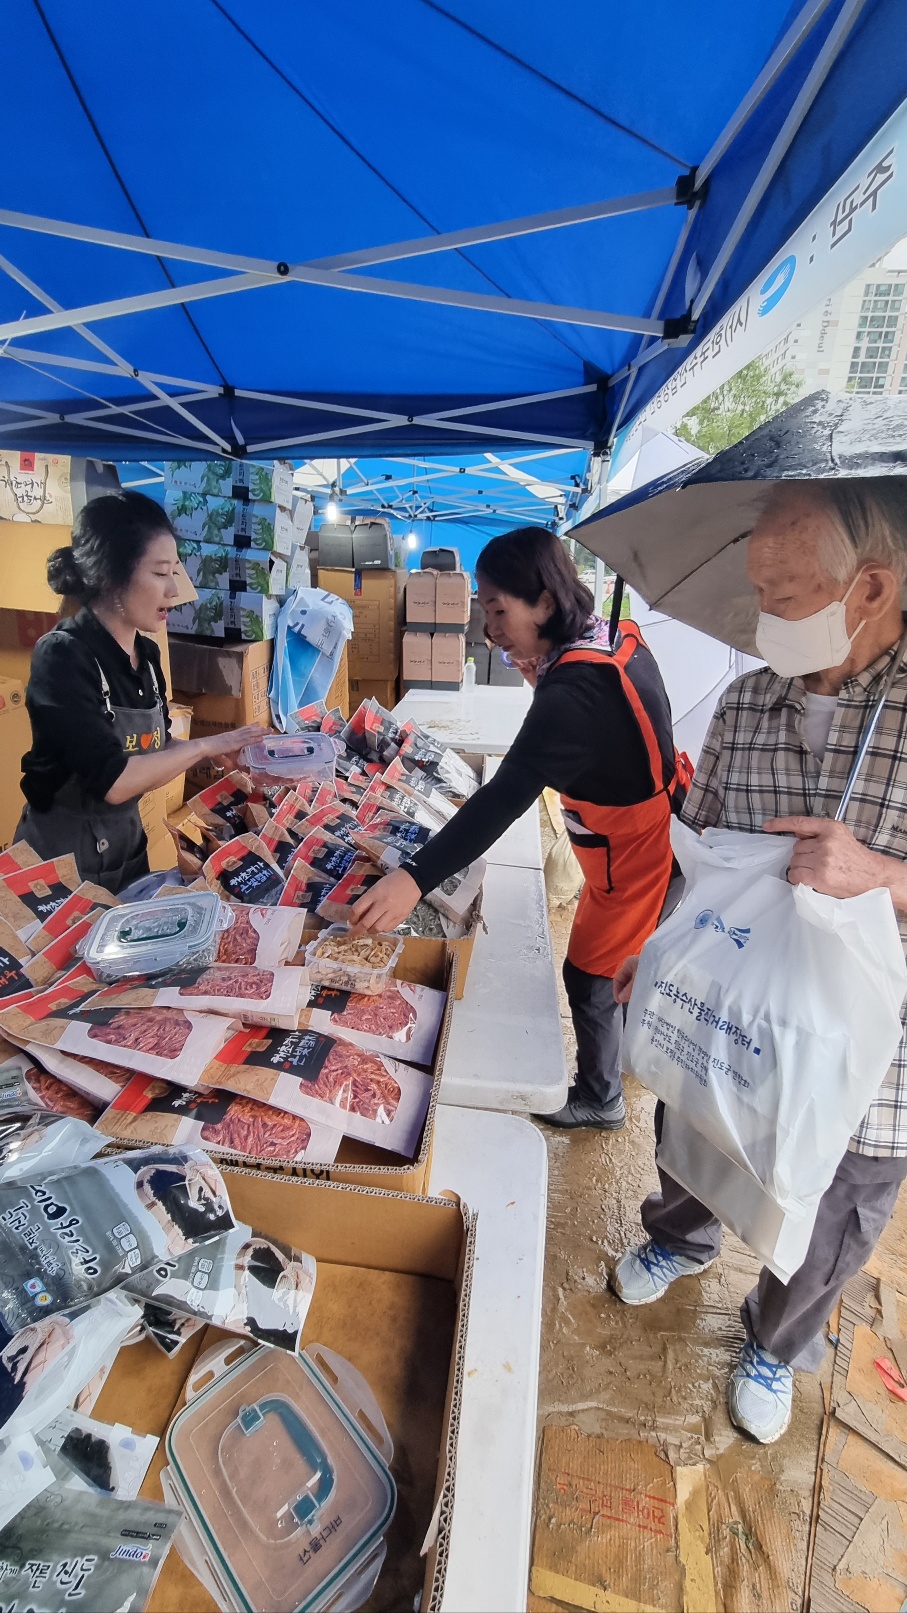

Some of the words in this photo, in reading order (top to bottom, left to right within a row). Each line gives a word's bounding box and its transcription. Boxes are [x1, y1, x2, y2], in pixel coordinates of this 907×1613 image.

[711, 1057, 732, 1075] 진도군
[1, 1200, 30, 1232] 진도
[23, 1224, 42, 1250] 자른
[52, 1216, 99, 1278] 아리랑
[110, 1544, 143, 1562] Jindo
[22, 1562, 50, 1590] 자른
[55, 1555, 97, 1597] 진도
